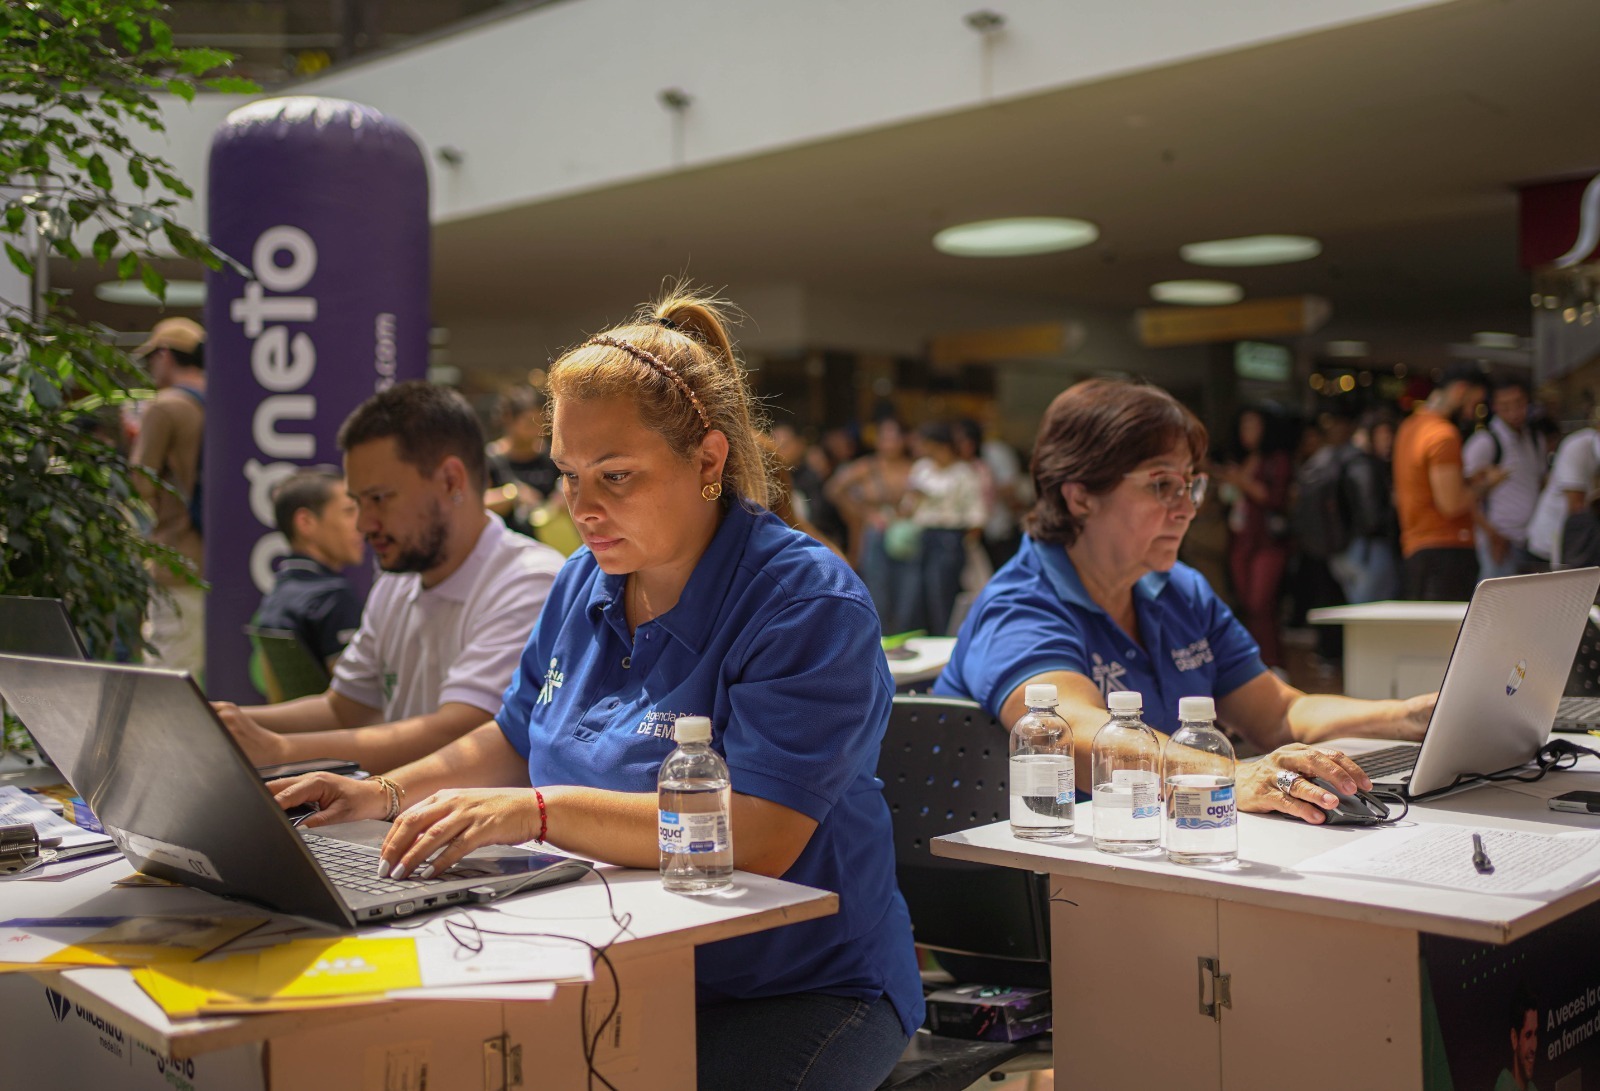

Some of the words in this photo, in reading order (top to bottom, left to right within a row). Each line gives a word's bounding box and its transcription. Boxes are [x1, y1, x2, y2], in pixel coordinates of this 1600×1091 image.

[643, 709, 676, 723] Agencia
[636, 721, 654, 735] DE
[1207, 803, 1234, 819] agua
[1546, 1008, 1555, 1032] A
[1556, 994, 1586, 1025] veces
[1586, 987, 1596, 1009] la
[1547, 1039, 1562, 1060] en
[1561, 1018, 1593, 1052] forma
